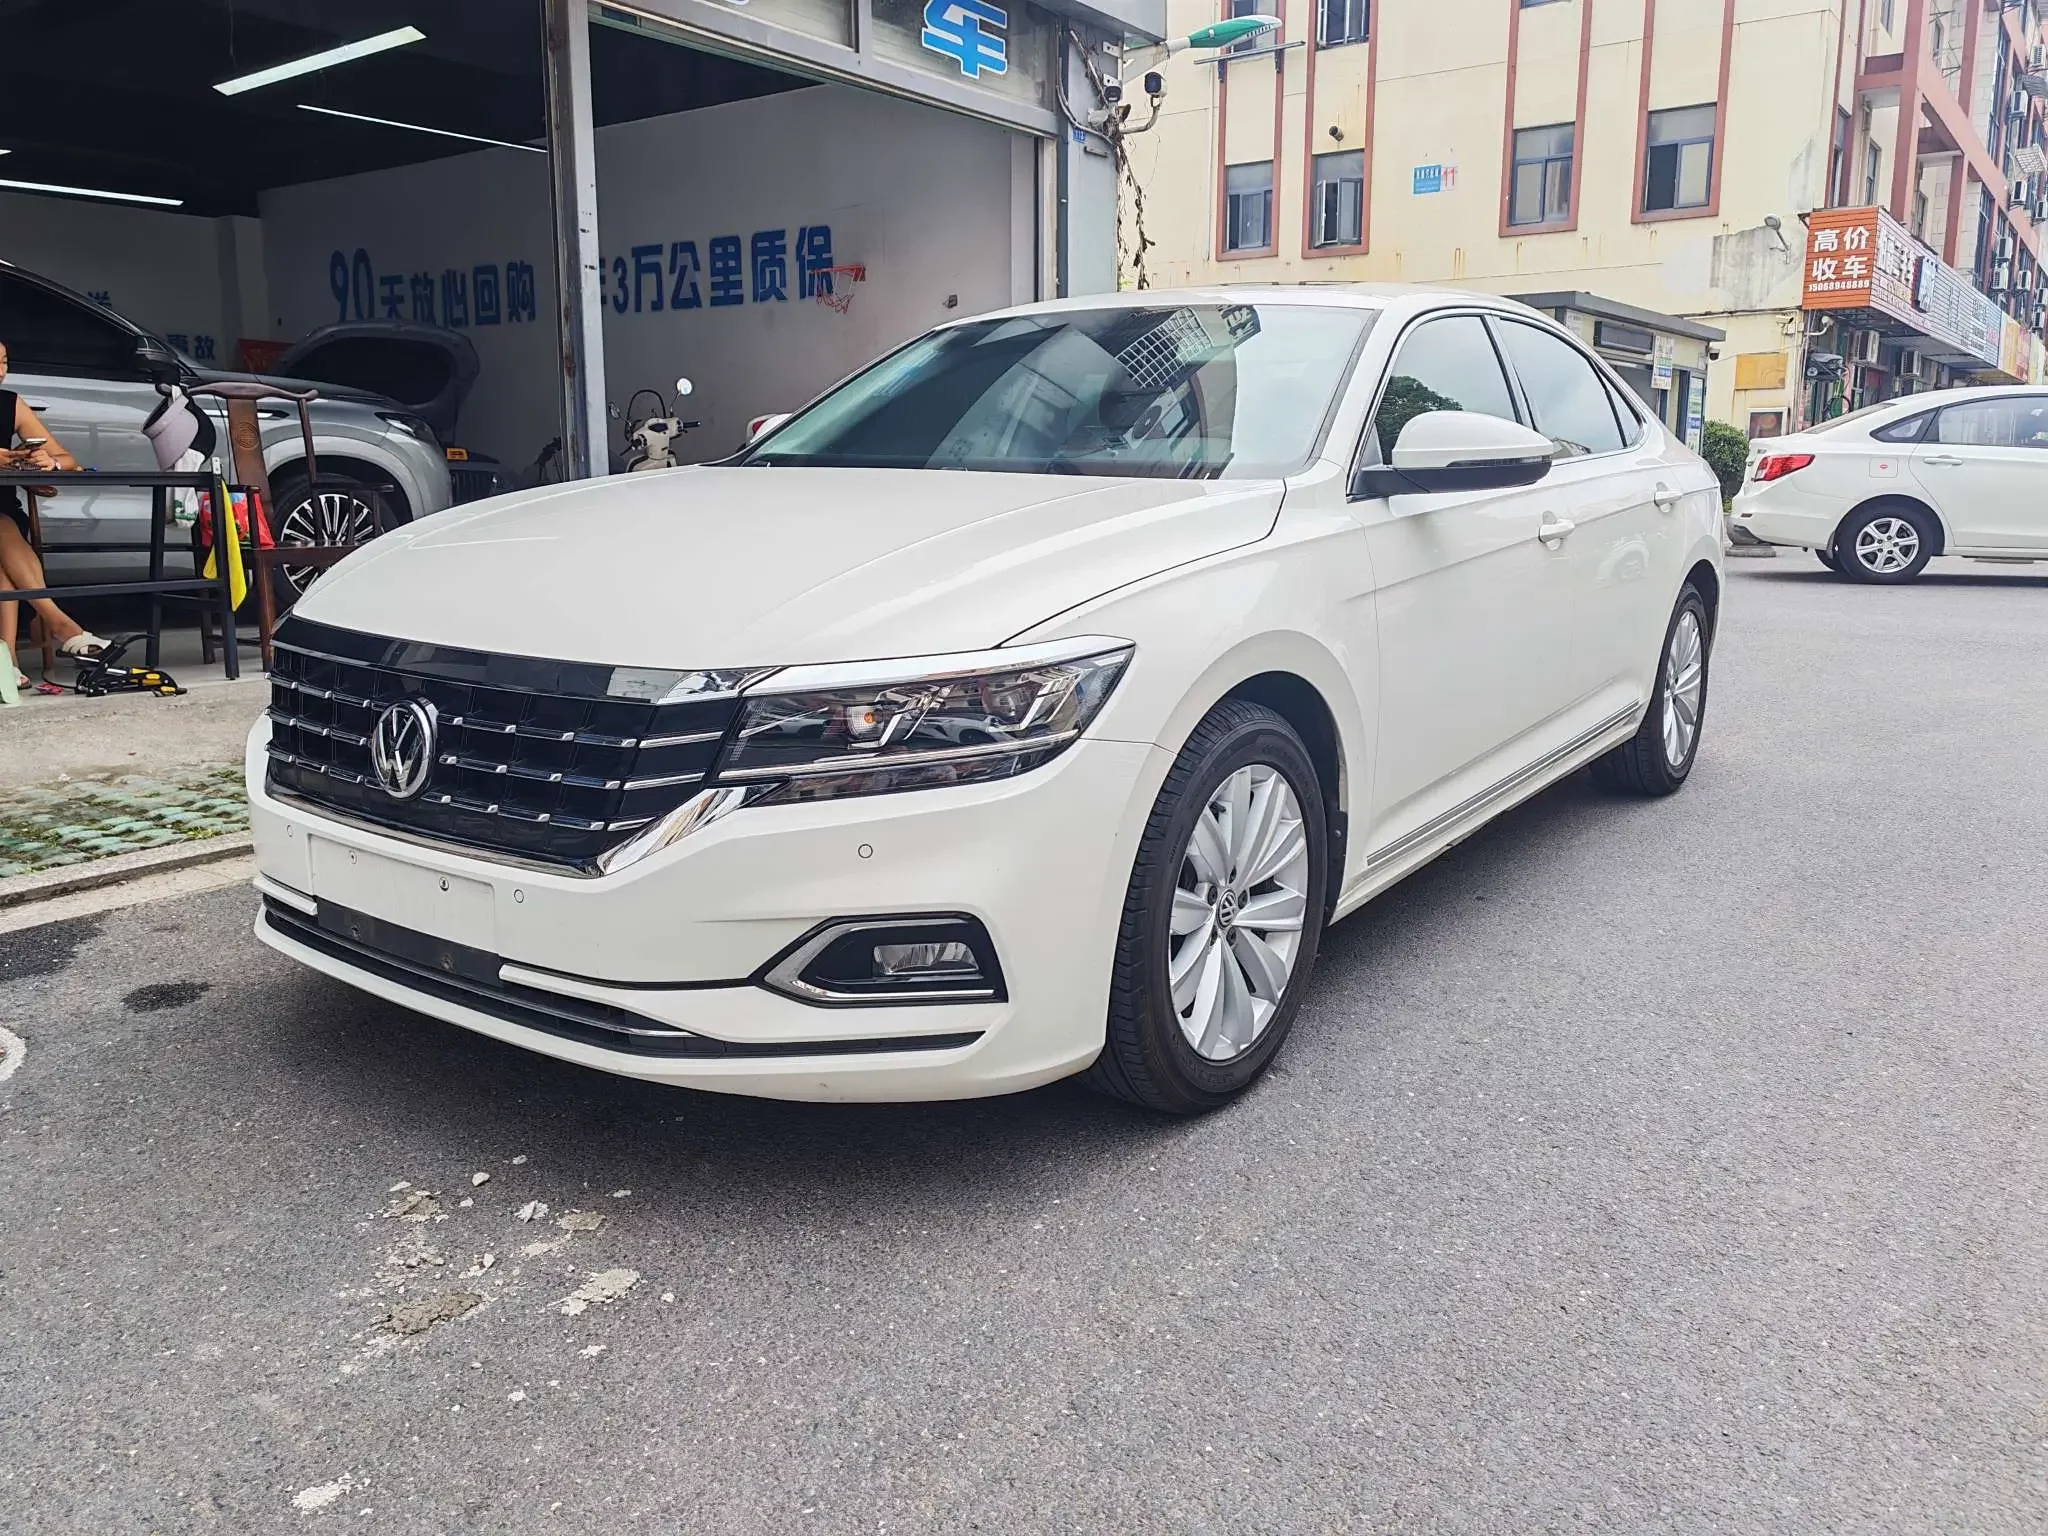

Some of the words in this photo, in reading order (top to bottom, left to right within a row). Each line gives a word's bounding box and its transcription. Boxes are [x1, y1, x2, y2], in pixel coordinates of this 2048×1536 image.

[922, 0, 1008, 80] 车
[600, 225, 834, 315] 3万公里质保
[1812, 255, 1869, 281] 收车
[1814, 225, 1870, 253] 高价
[329, 248, 536, 328] 90天放心回购
